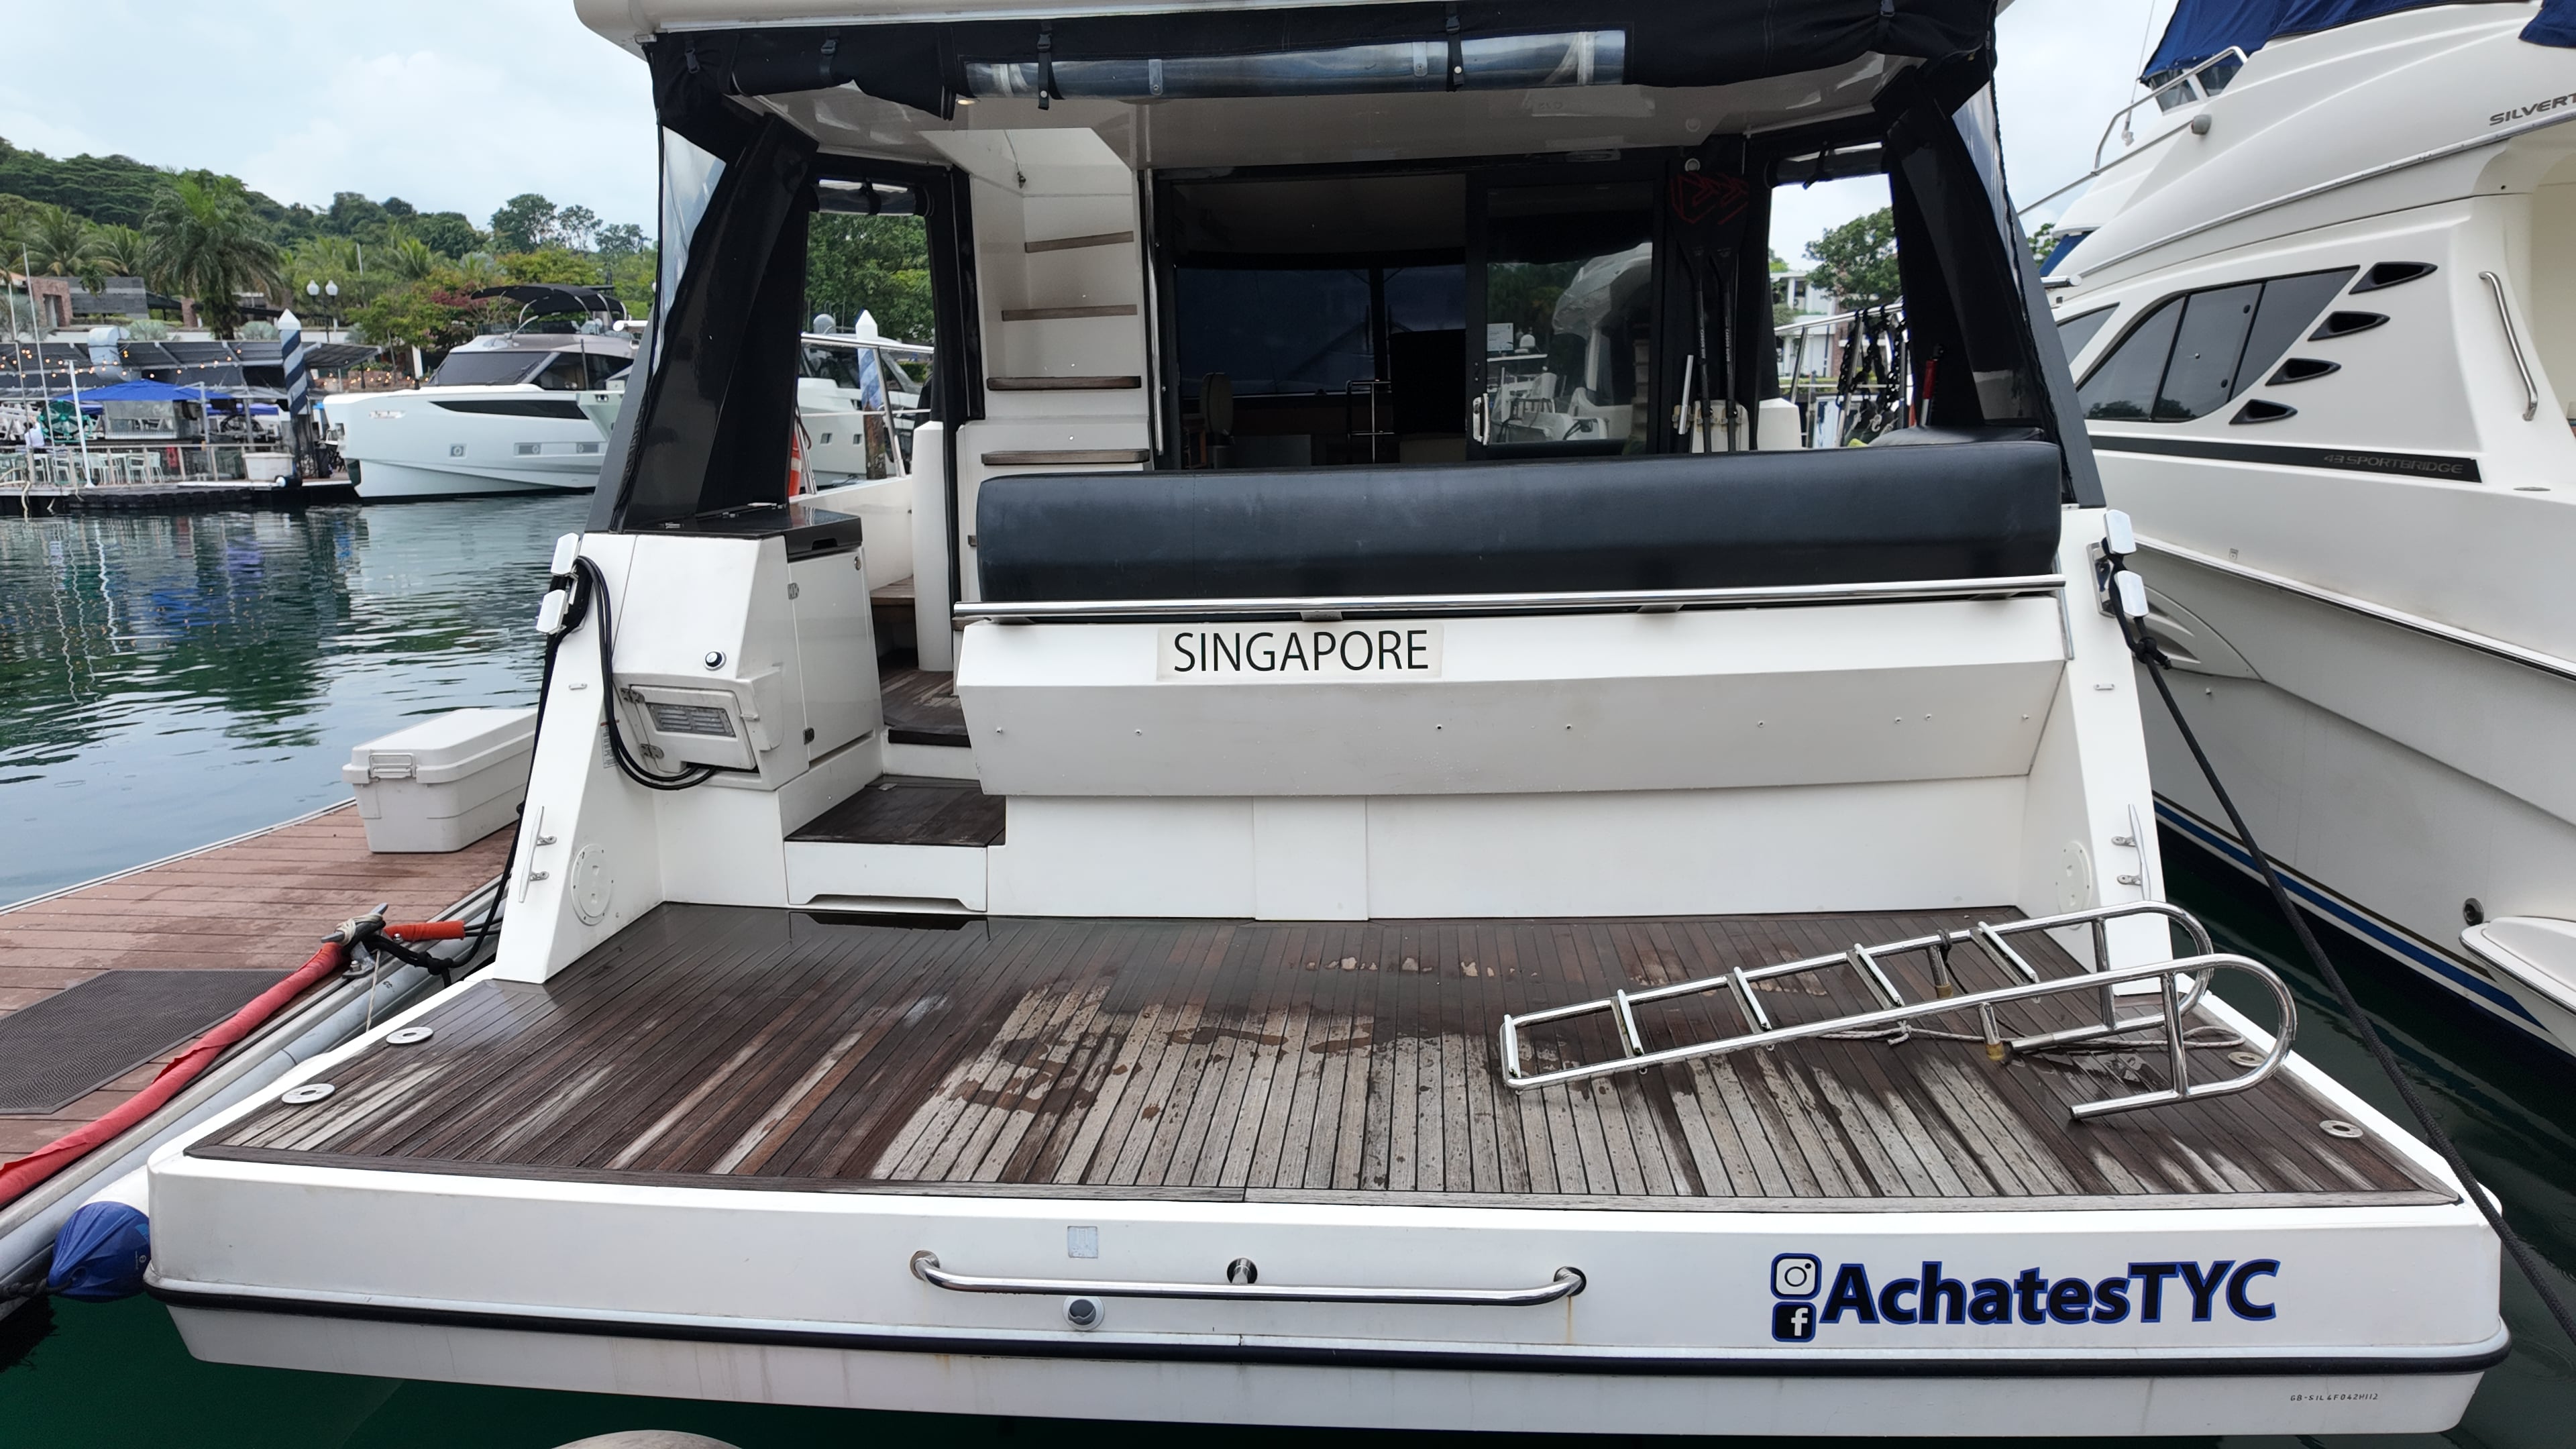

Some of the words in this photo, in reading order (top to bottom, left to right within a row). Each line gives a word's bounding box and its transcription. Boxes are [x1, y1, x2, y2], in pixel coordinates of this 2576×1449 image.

[2324, 454, 2344, 464] 43
[2346, 455, 2463, 474] SPORTBRIDGE
[1174, 629, 1428, 672] SINGAPORE
[1819, 1258, 2280, 1325] AchatesTYC
